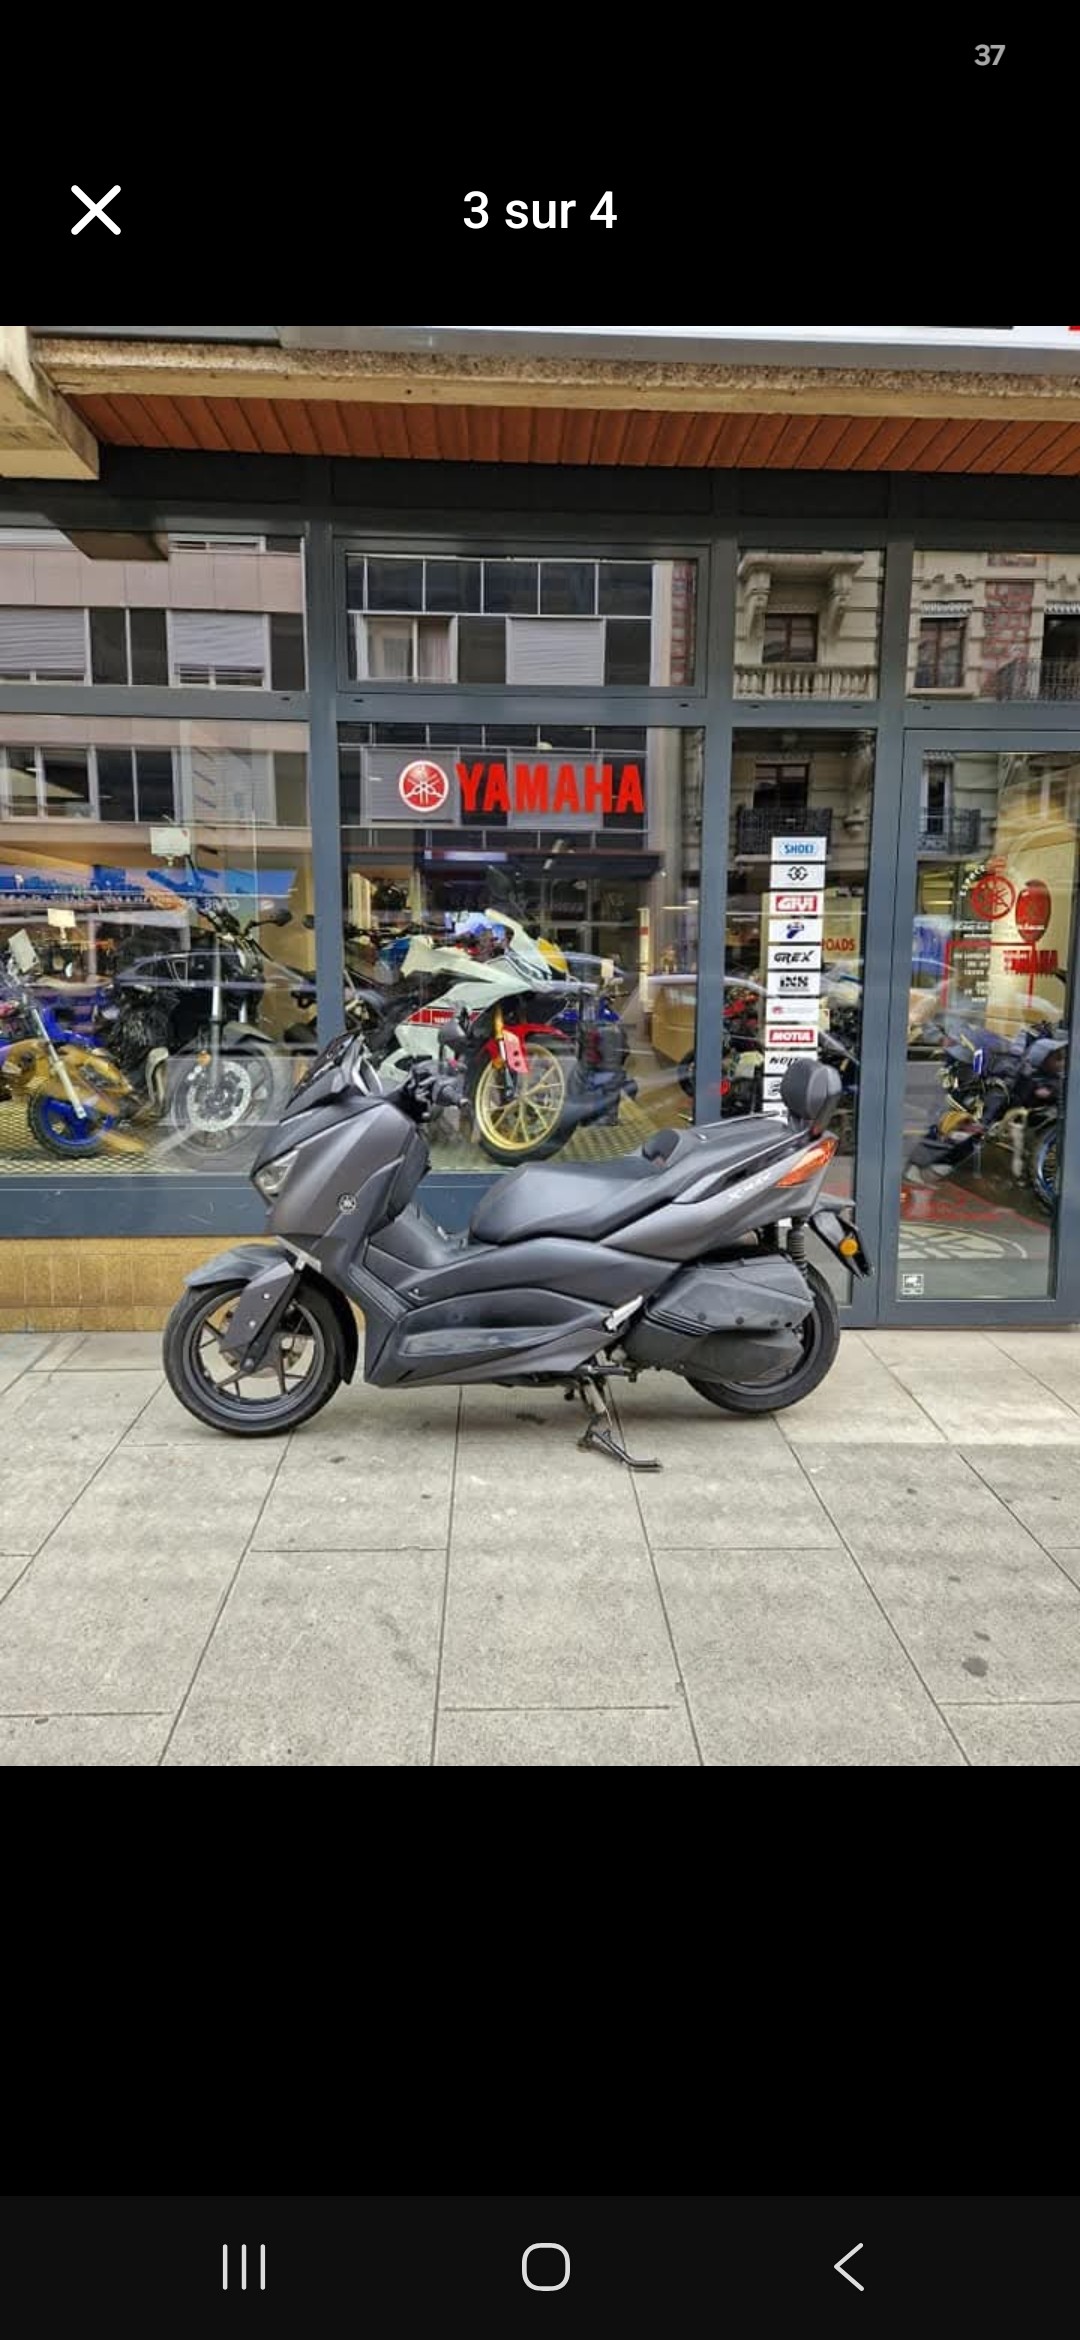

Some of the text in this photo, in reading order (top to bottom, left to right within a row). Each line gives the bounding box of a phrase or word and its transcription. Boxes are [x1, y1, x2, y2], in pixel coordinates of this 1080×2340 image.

[456, 763, 645, 813] YAMAHA
[784, 843, 814, 854] SHOEI
[777, 896, 816, 911] GIVI
[774, 951, 815, 963] GREX
[771, 1032, 811, 1041] MOTUL
